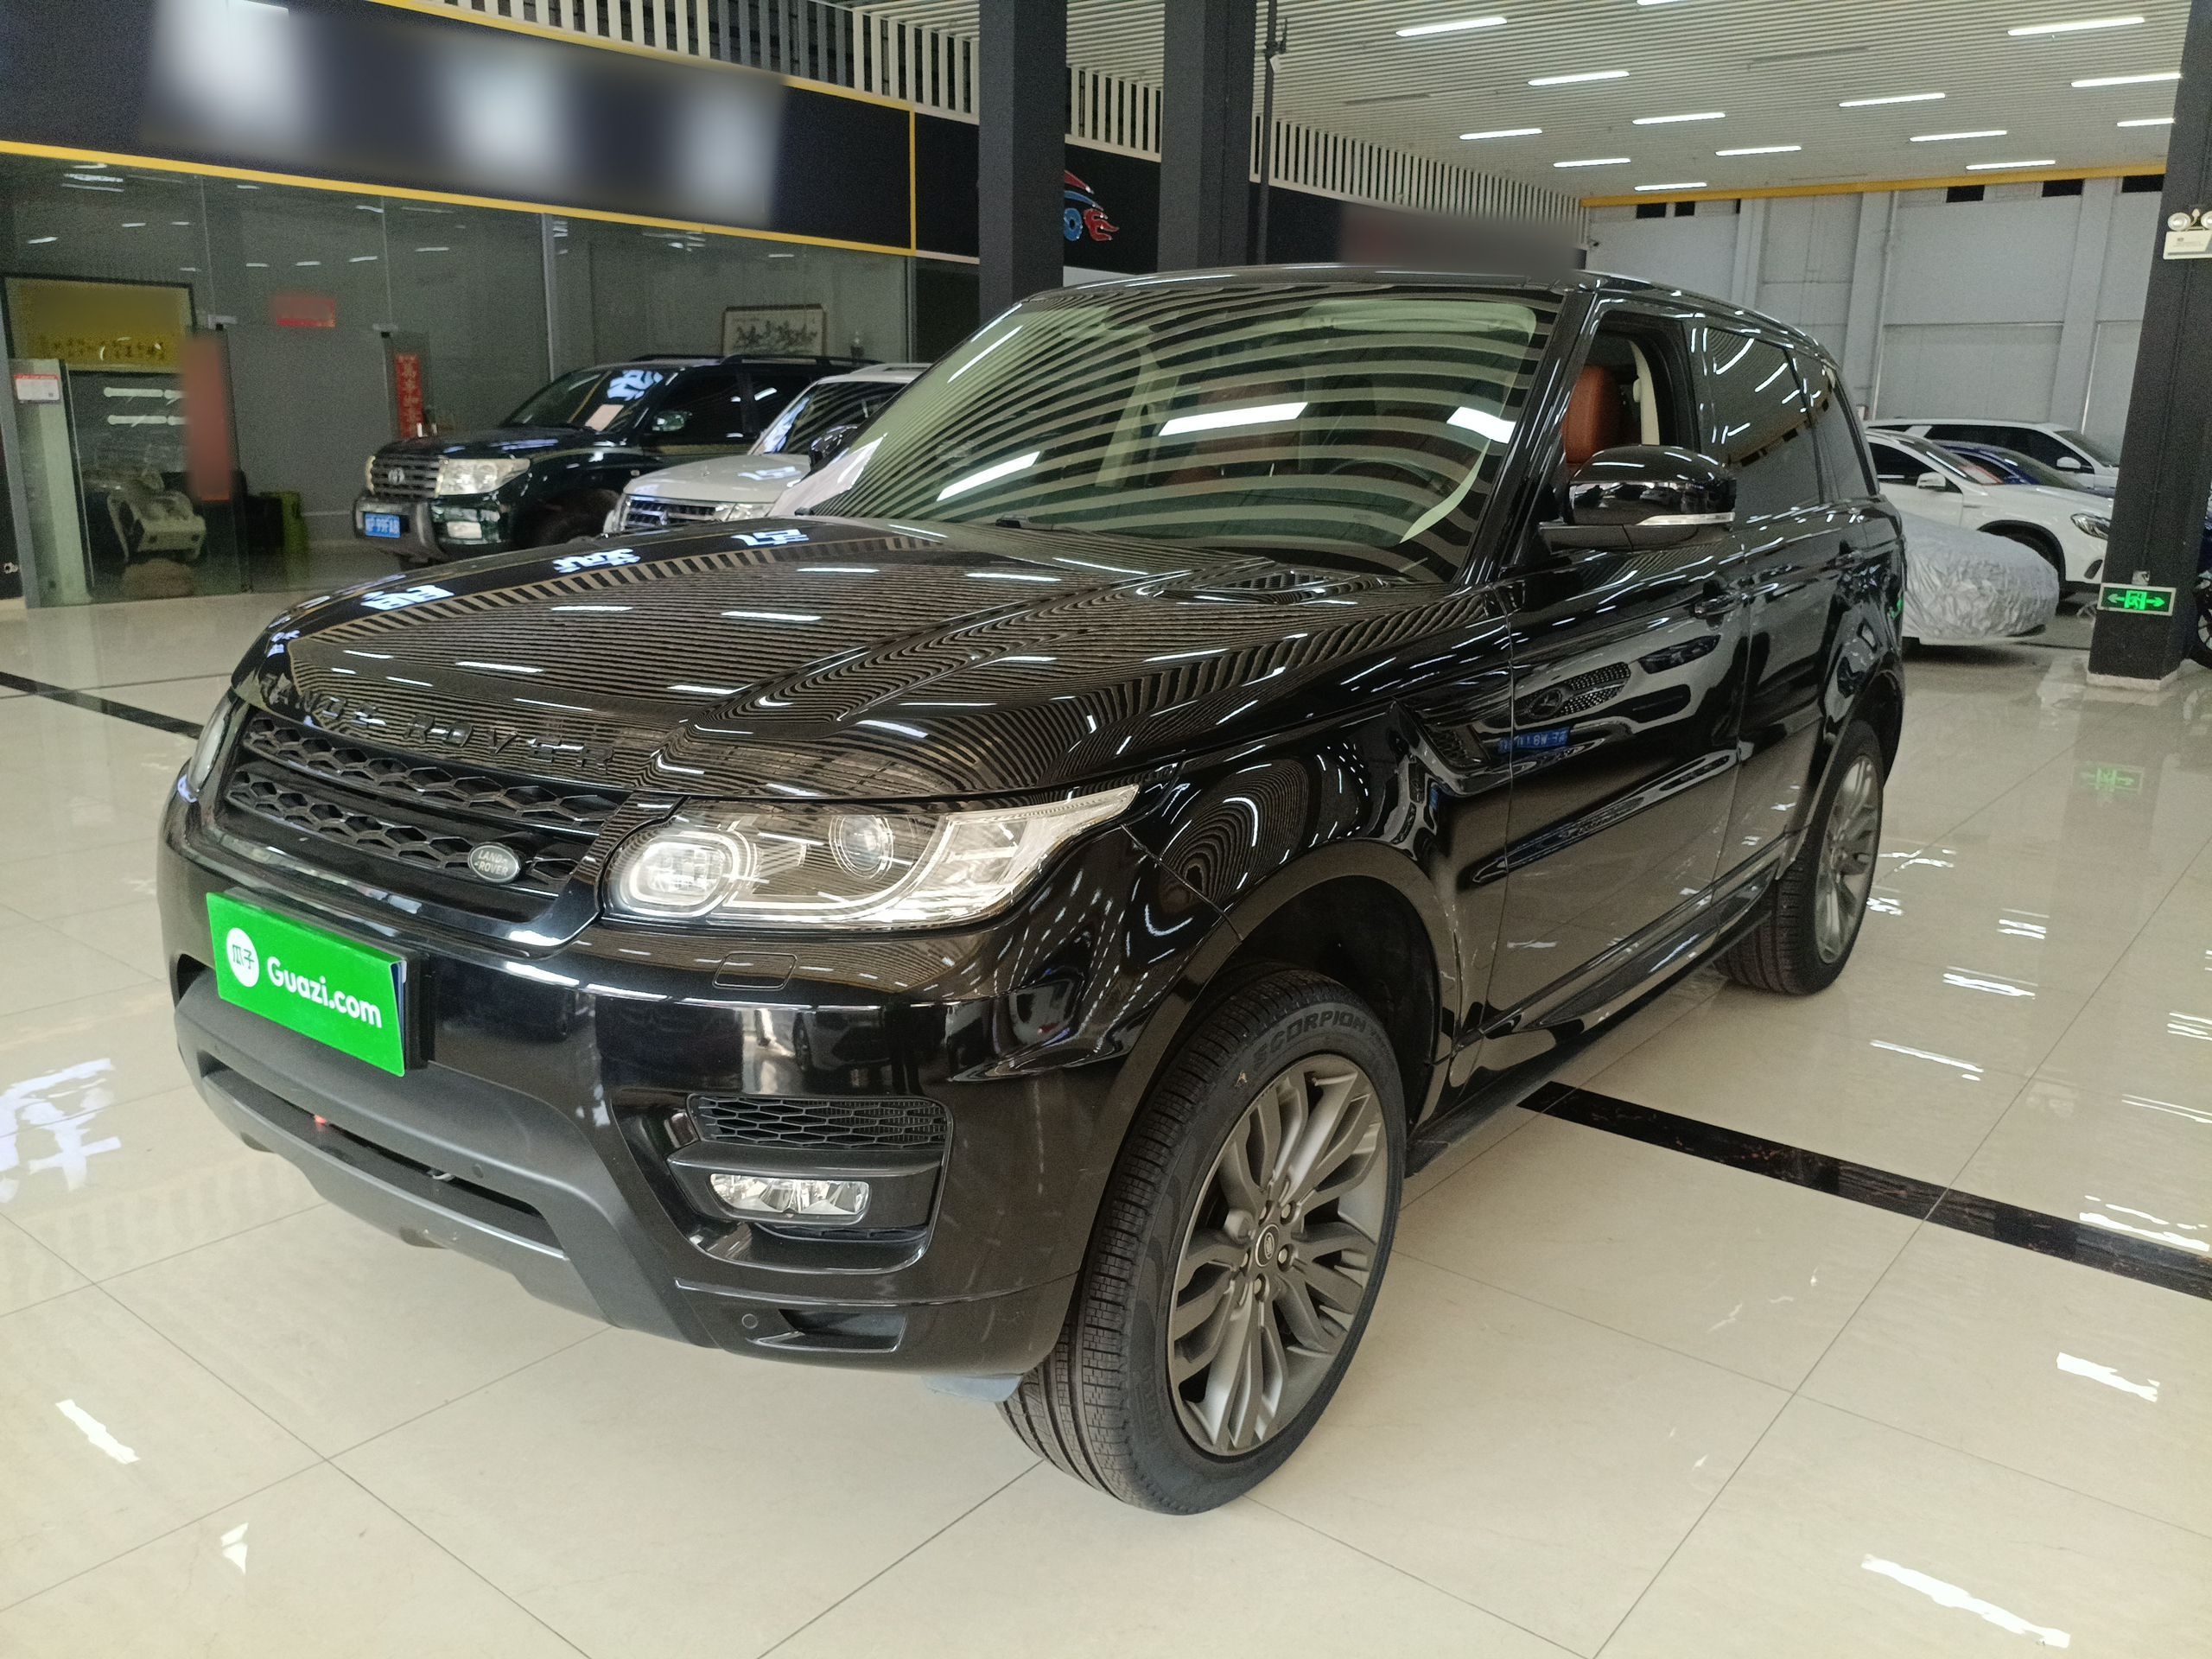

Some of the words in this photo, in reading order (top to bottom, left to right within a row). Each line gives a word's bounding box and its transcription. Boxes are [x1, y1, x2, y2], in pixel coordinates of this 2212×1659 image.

[262, 671, 382, 728] RANGE
[404, 715, 615, 771] ROVER
[478, 849, 503, 863] LAND
[478, 861, 509, 876] ROVER
[232, 943, 256, 970] 瓜子
[266, 956, 383, 1029] Guazi.com
[1253, 1009, 1368, 1068] SCORPION
